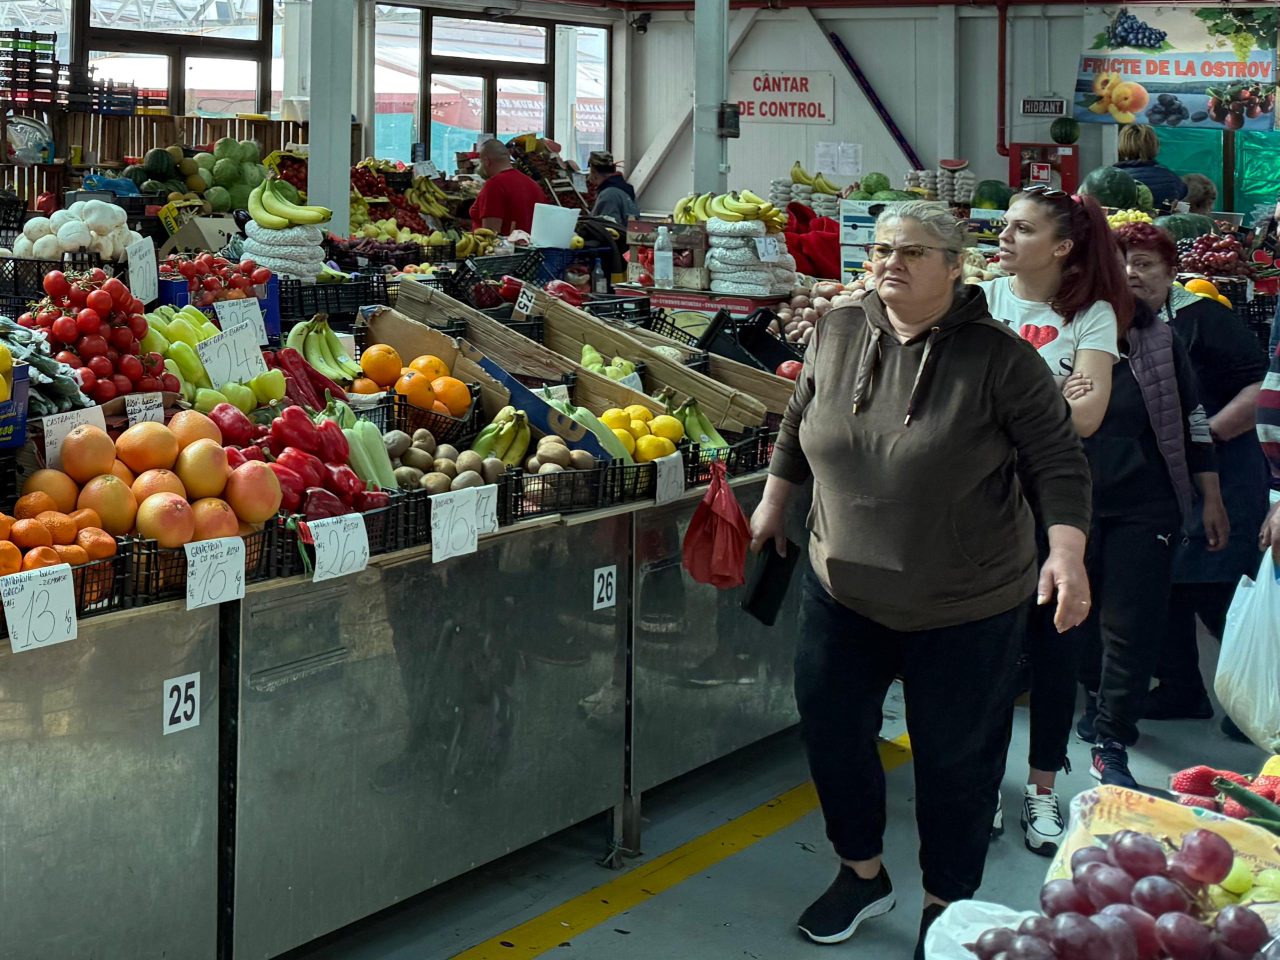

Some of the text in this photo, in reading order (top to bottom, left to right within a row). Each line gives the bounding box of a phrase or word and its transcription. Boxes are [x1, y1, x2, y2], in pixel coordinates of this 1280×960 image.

[1082, 57, 1272, 78] FRUCTE DE LA OSTROV
[753, 74, 809, 92] CÂNTAR
[738, 100, 826, 118] DE CONTROL
[1024, 101, 1061, 112] HIDRANT
[596, 571, 613, 603] 26
[20, 589, 55, 649] 13
[168, 680, 196, 726] 25
